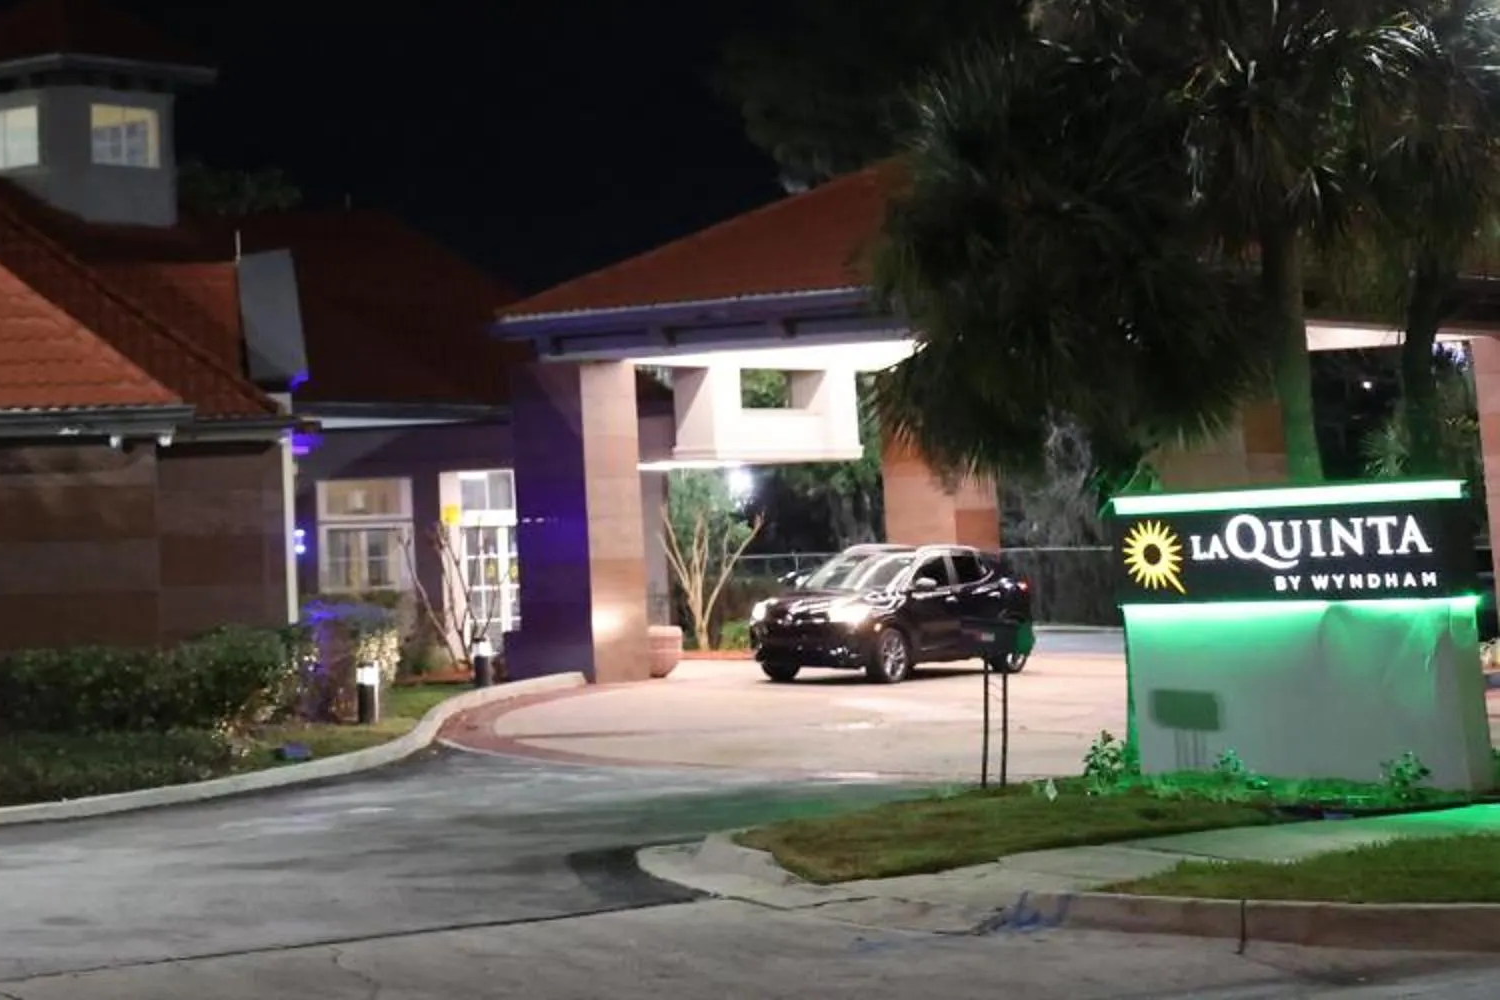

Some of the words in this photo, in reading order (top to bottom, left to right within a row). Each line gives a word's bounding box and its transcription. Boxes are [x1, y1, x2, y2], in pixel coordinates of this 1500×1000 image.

[1225, 513, 1433, 569] QUINTA
[1274, 575, 1301, 591] BY
[1311, 571, 1437, 591] WYNDHAM
